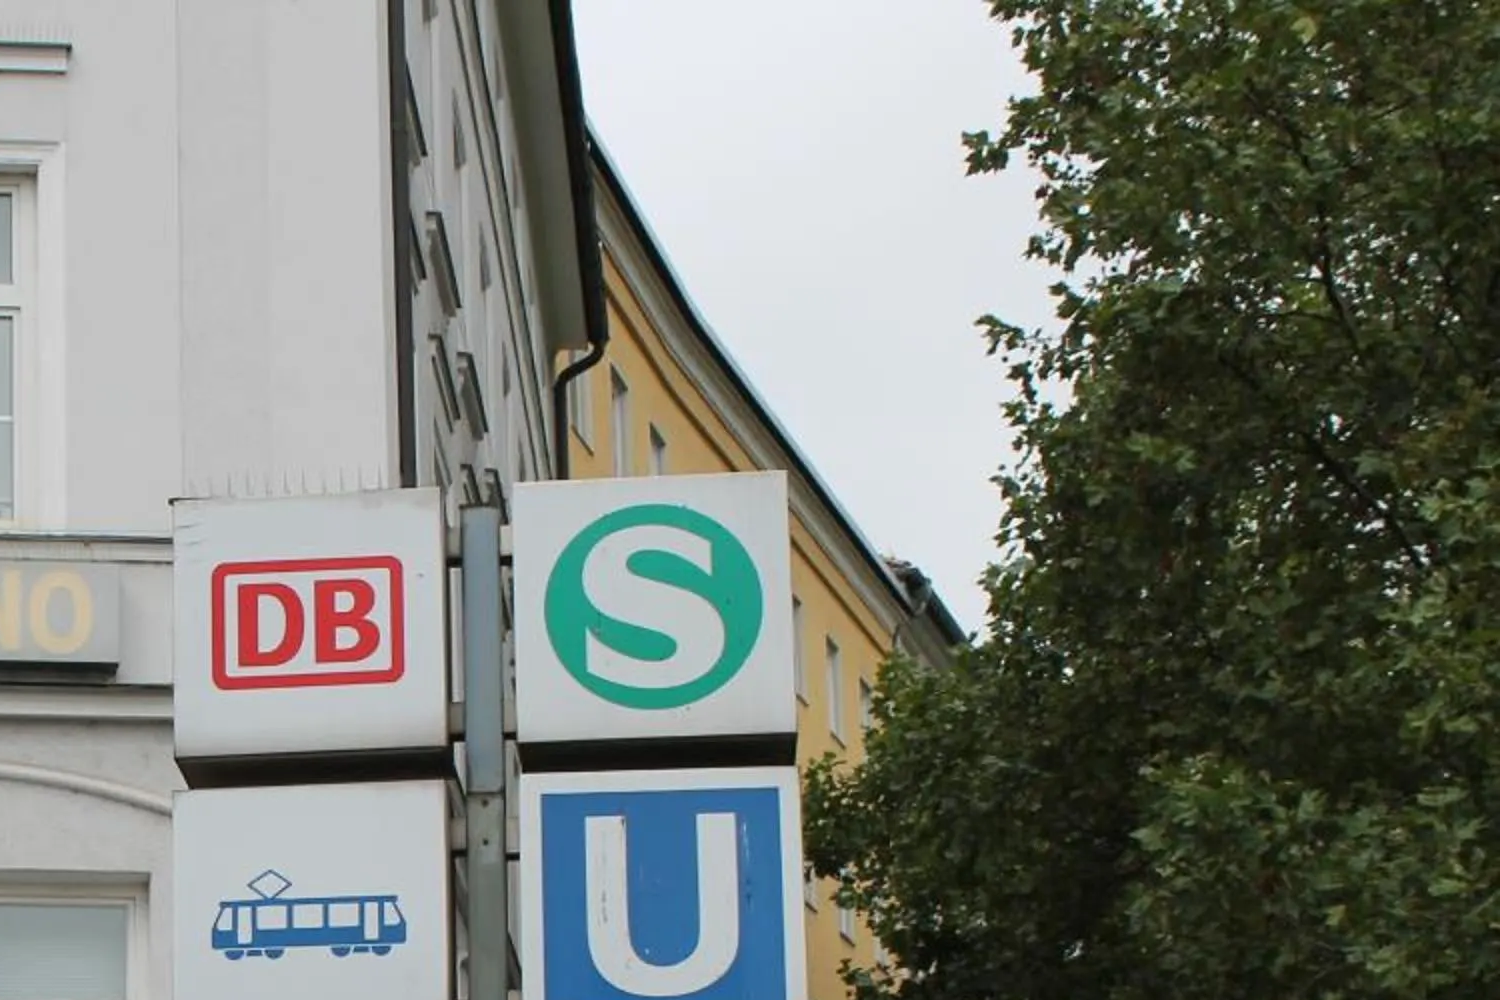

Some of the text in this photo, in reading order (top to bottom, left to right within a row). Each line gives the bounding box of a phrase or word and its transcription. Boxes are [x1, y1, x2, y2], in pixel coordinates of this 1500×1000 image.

[237, 578, 381, 668] DB
[581, 523, 726, 690] S
[584, 811, 741, 998] U
